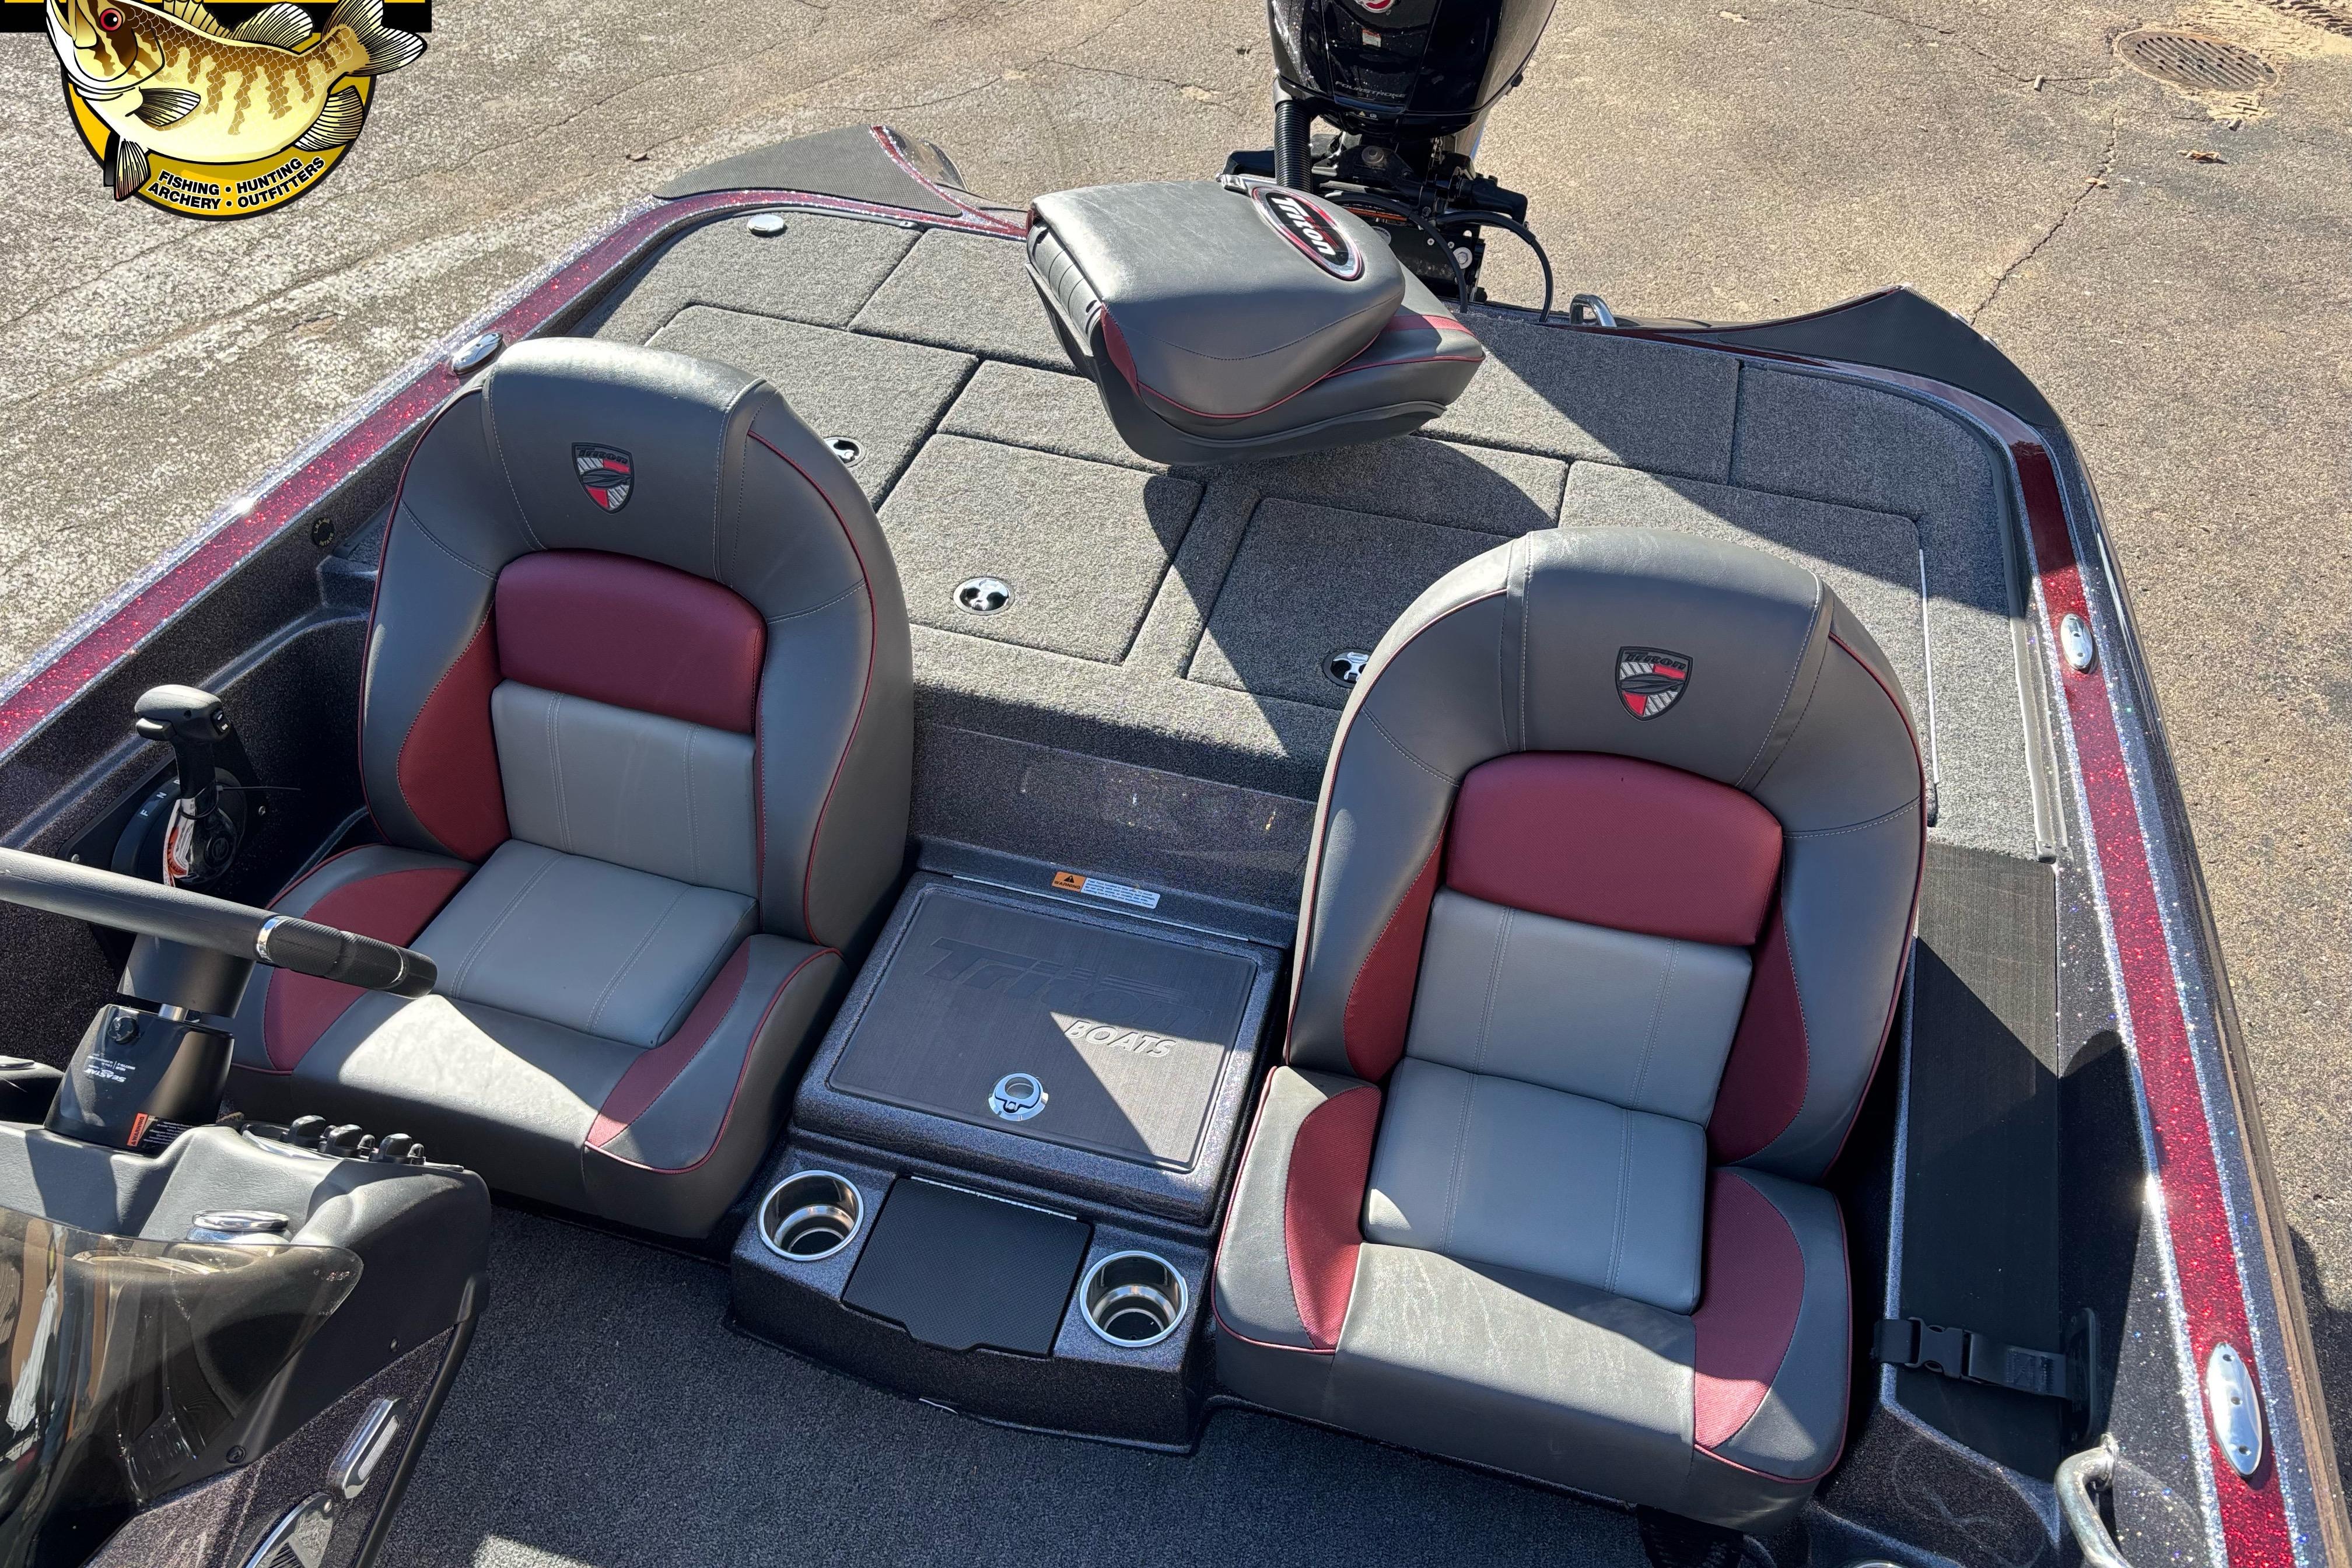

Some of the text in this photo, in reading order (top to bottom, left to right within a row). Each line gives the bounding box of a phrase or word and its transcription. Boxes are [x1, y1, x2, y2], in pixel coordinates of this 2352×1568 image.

[1054, 880, 1081, 890] WARNING
[1063, 1020, 1177, 1058] BOATS
[132, 1116, 145, 1141] WARNING
